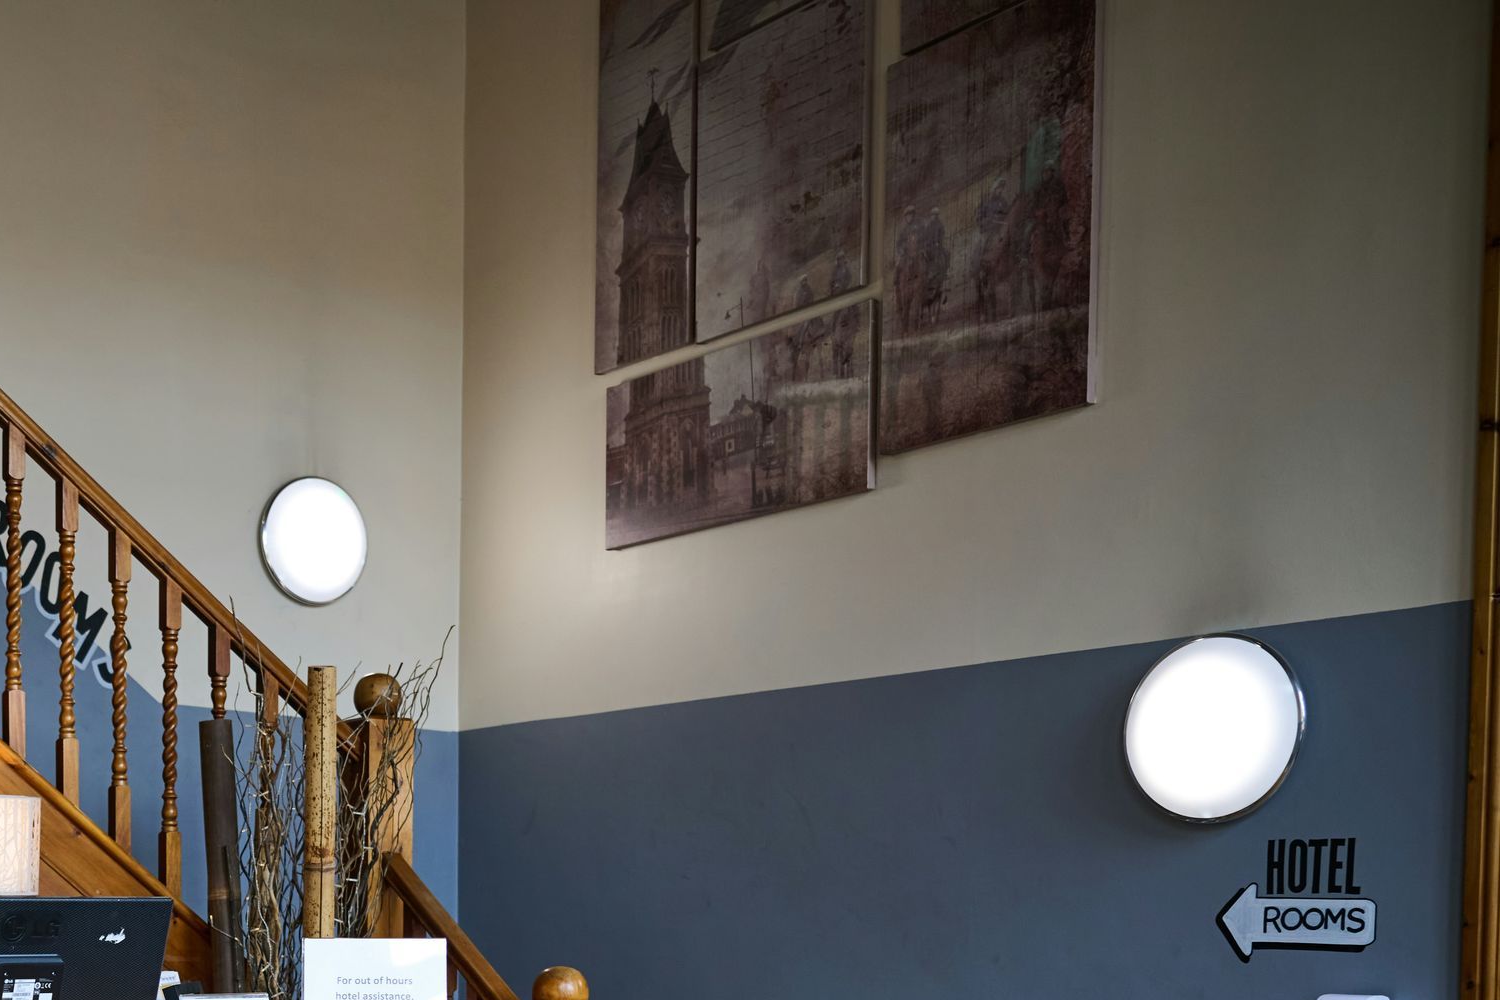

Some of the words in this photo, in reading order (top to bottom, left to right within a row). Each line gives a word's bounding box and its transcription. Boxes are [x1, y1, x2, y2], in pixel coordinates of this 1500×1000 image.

[1266, 837, 1361, 895] HOTEL
[1263, 906, 1366, 934] ROOMS
[337, 976, 352, 985] For
[354, 977, 371, 985] out
[373, 976, 384, 985] of
[386, 976, 413, 985] hours
[335, 992, 360, 1000] hotel
